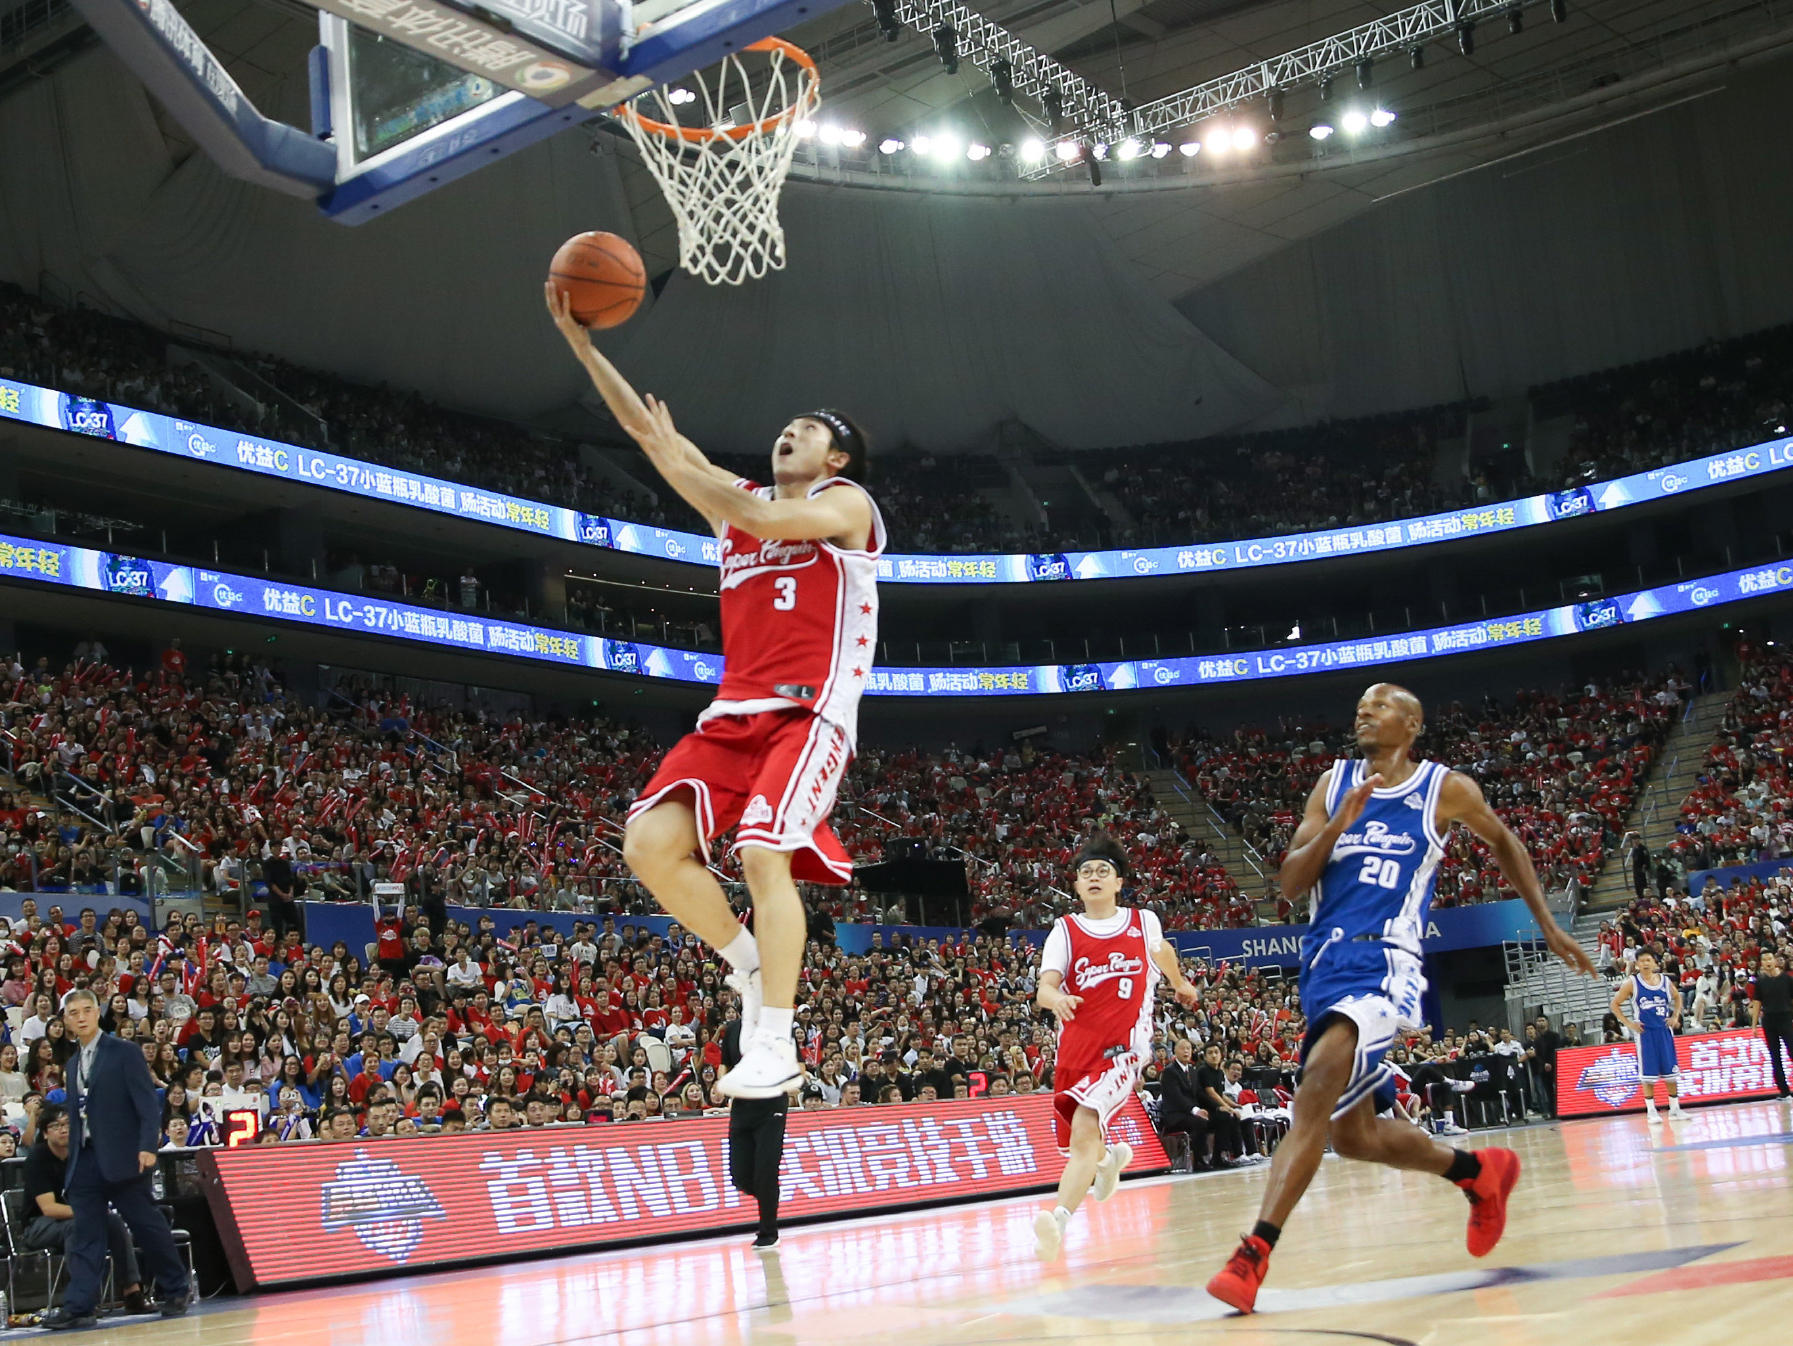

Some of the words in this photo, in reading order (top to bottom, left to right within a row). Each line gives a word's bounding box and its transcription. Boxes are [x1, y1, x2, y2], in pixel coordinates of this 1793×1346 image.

[69, 412, 107, 427] LC-37
[237, 440, 289, 471] 优益C
[1707, 453, 1761, 479] 优益C
[1555, 495, 1588, 516] LC-37
[581, 526, 608, 541] LC-37
[1178, 548, 1227, 568] 优益C
[109, 571, 148, 587] LC-37
[1034, 562, 1066, 577] LC-37
[1739, 566, 1792, 593] 优益C
[263, 587, 316, 616] 优益C
[773, 576, 797, 611] 3
[1583, 606, 1616, 627] LC-37
[609, 653, 637, 667] LC-37
[1199, 659, 1249, 679] 优益C
[1066, 672, 1099, 688] LC-37
[1334, 831, 1362, 850] per
[1363, 820, 1412, 849] Penguin
[1358, 856, 1400, 889] 20
[1074, 957, 1109, 986] Super
[1117, 977, 1133, 999] 9
[1655, 1006, 1665, 1016] 32
[969, 1072, 986, 1097] 2
[229, 1110, 257, 1147] 2
